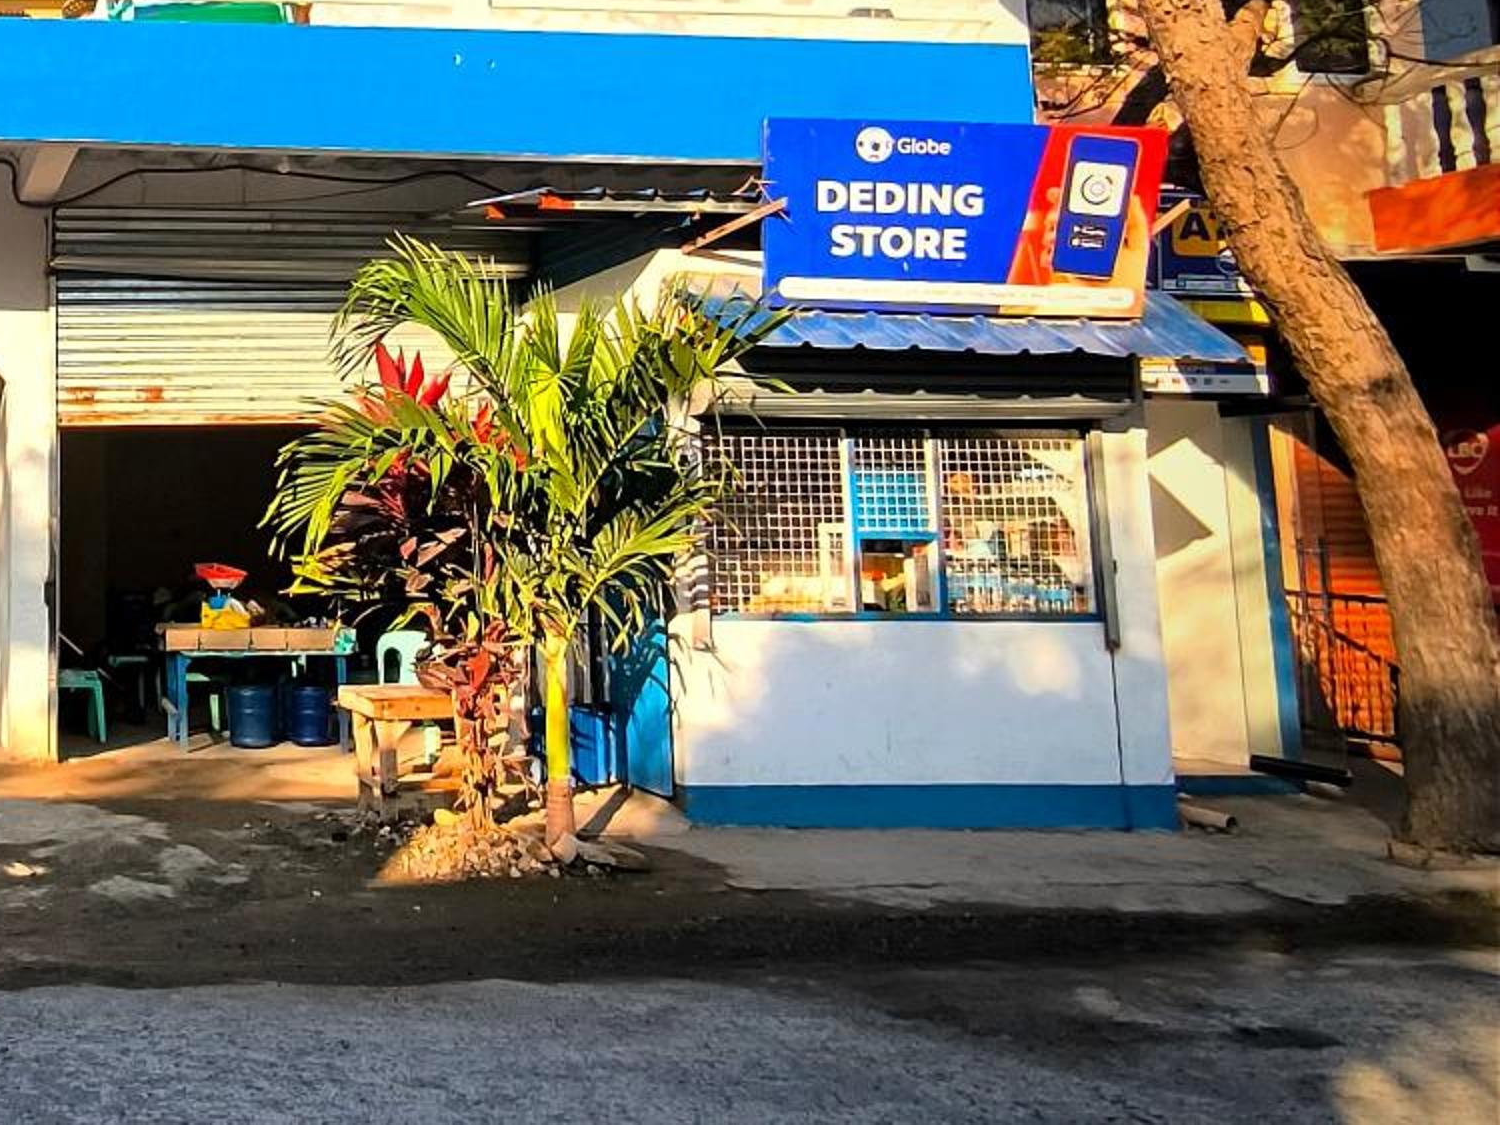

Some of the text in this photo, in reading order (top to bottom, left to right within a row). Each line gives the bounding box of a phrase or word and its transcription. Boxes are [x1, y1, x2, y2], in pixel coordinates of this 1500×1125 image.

[896, 137, 952, 156] Globe
[816, 180, 985, 217] DEDING
[829, 224, 968, 260] STORE
